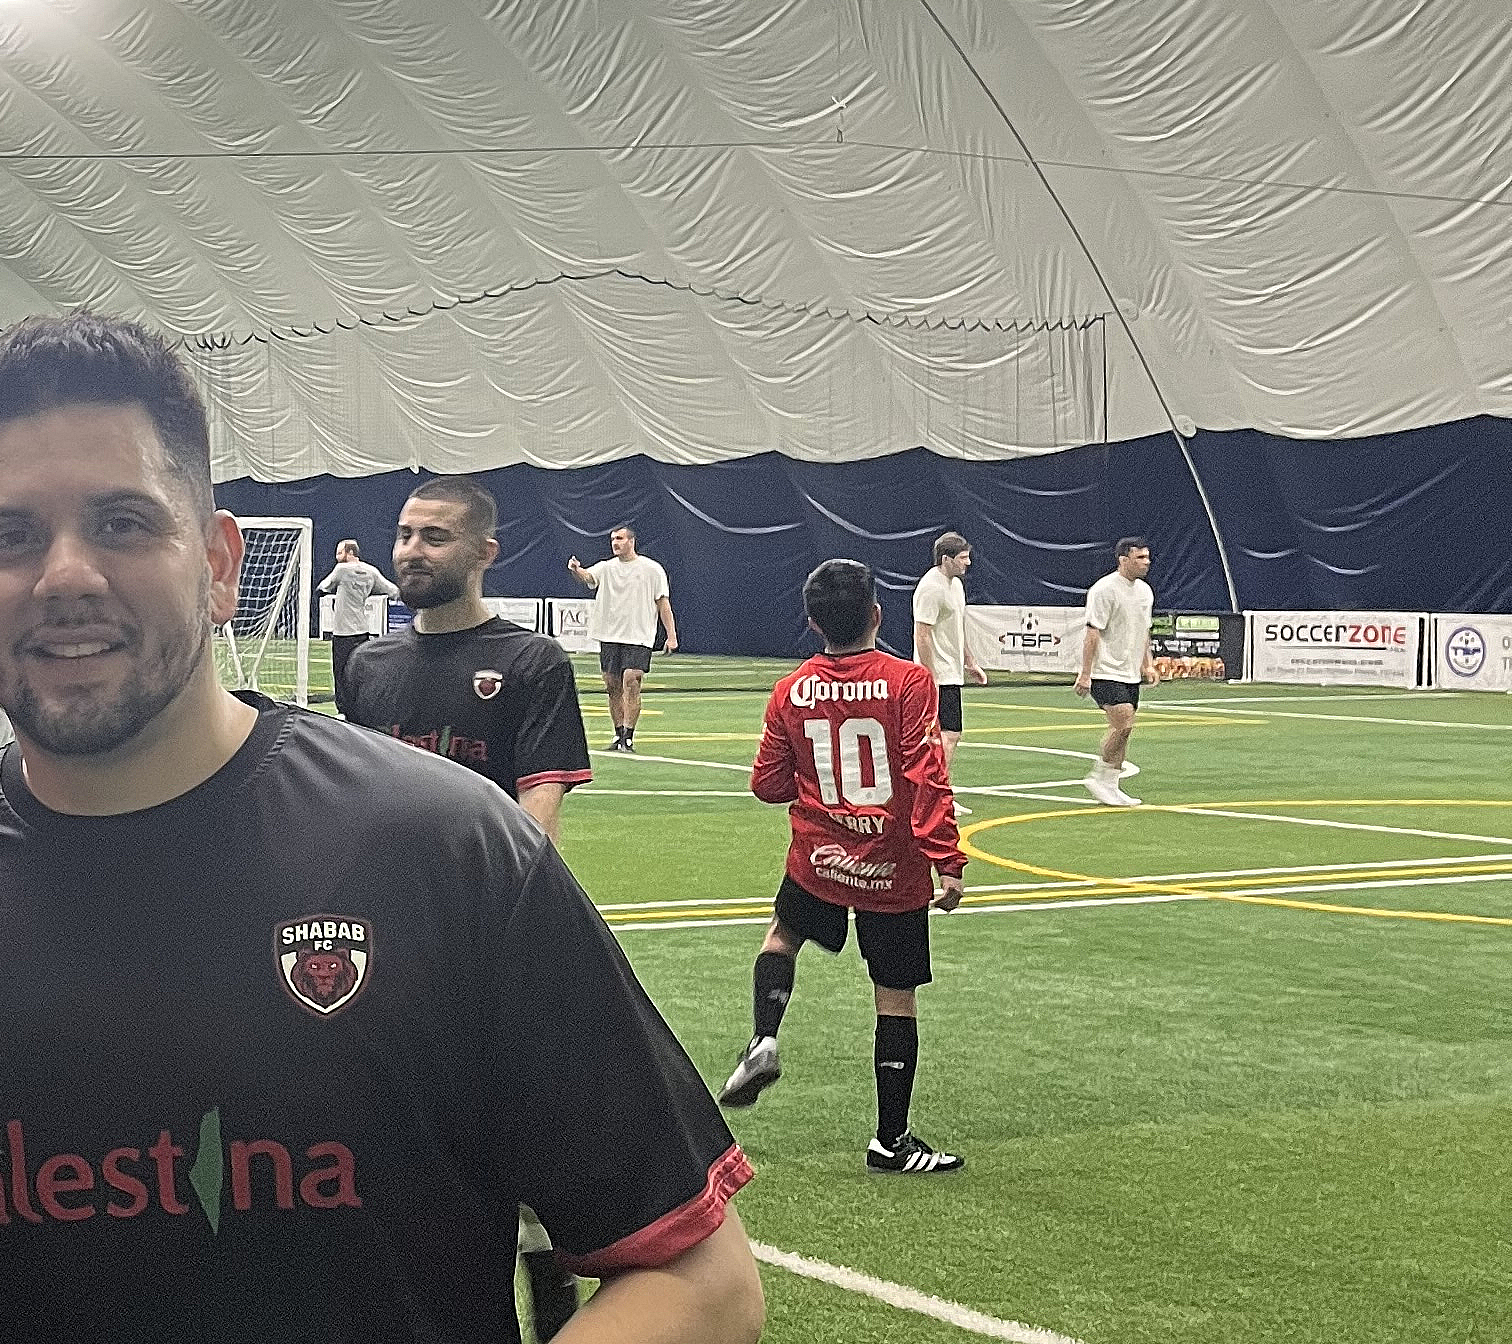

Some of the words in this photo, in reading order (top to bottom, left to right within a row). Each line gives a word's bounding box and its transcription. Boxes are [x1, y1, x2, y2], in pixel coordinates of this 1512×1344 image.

[790, 674, 889, 709] Corona
[804, 718, 893, 805] 10
[282, 921, 366, 945] SHABAB
[313, 939, 333, 951] FC
